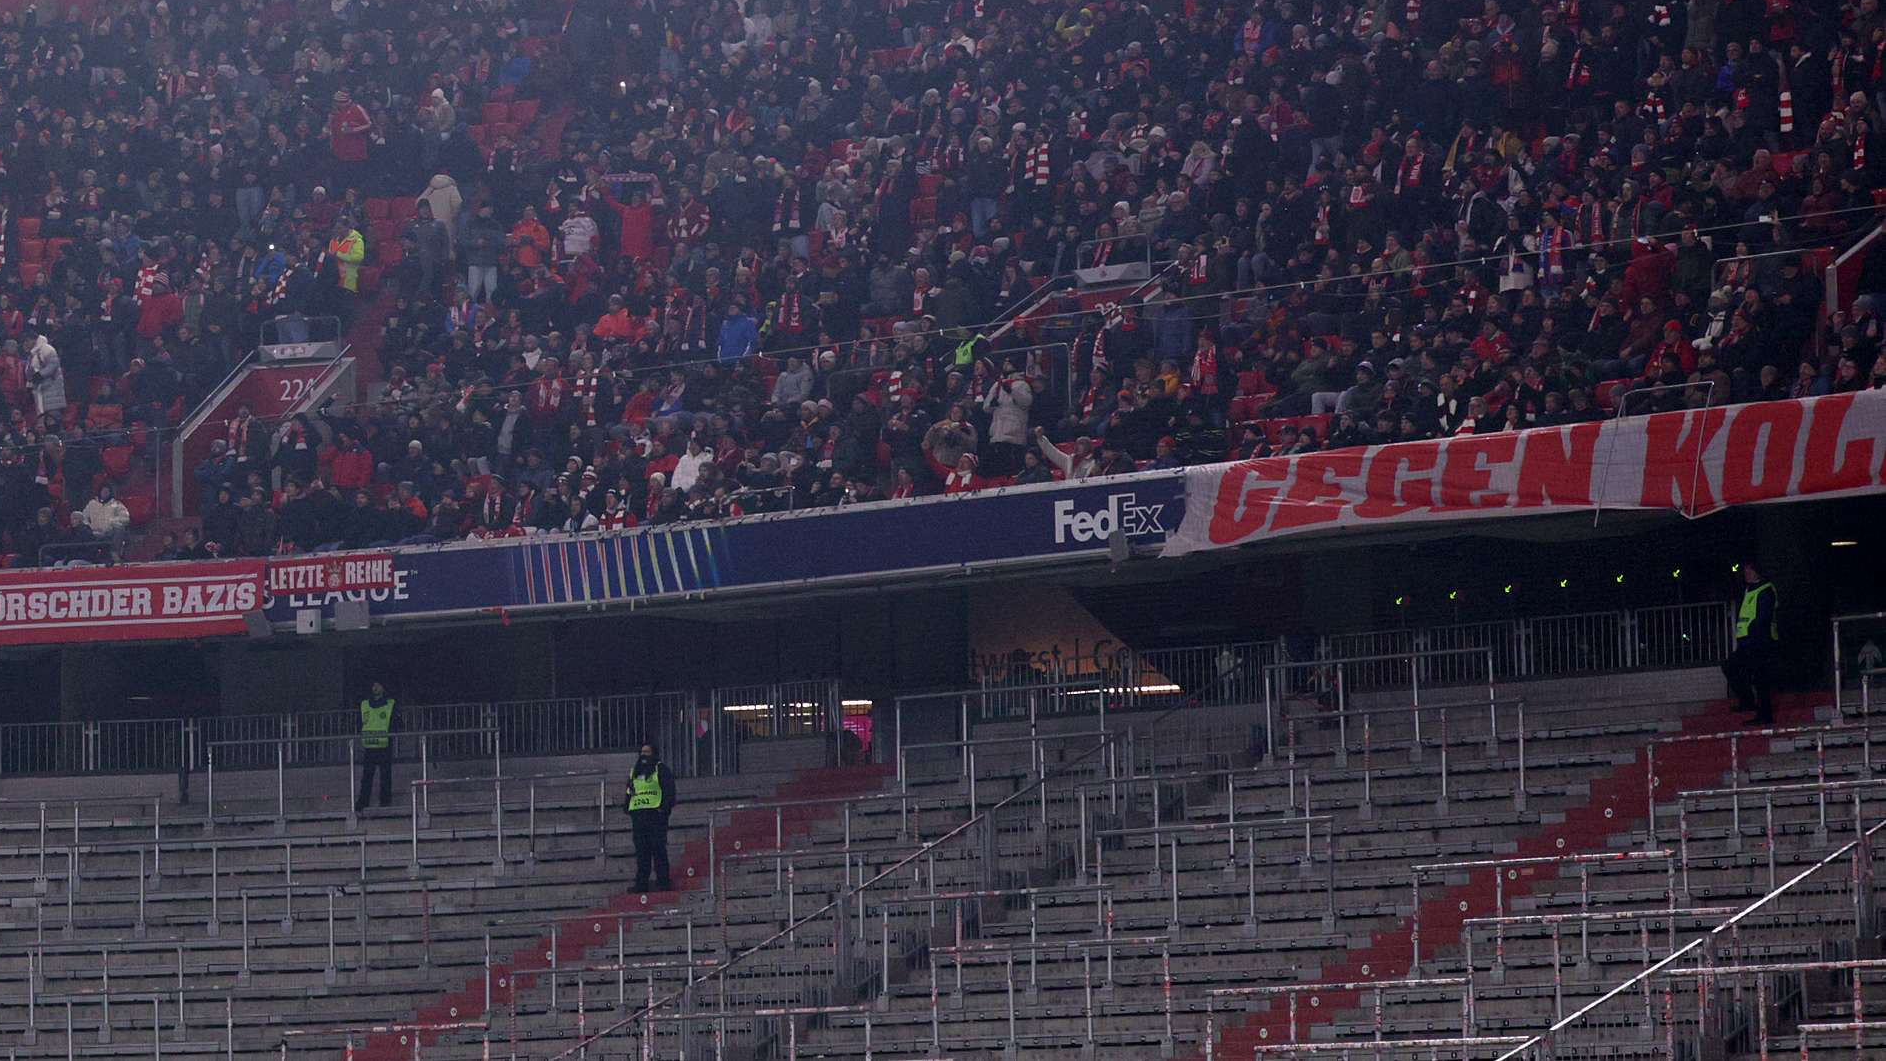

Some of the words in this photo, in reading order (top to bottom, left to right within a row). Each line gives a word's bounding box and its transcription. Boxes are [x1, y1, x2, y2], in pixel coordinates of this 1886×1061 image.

[1209, 421, 1602, 544] GEGEN
[1640, 394, 1886, 514] KOL
[1054, 492, 1165, 544] FedEx
[271, 564, 325, 591] LETZTE
[345, 559, 393, 585] REIHE
[162, 582, 257, 615] BAZIS
